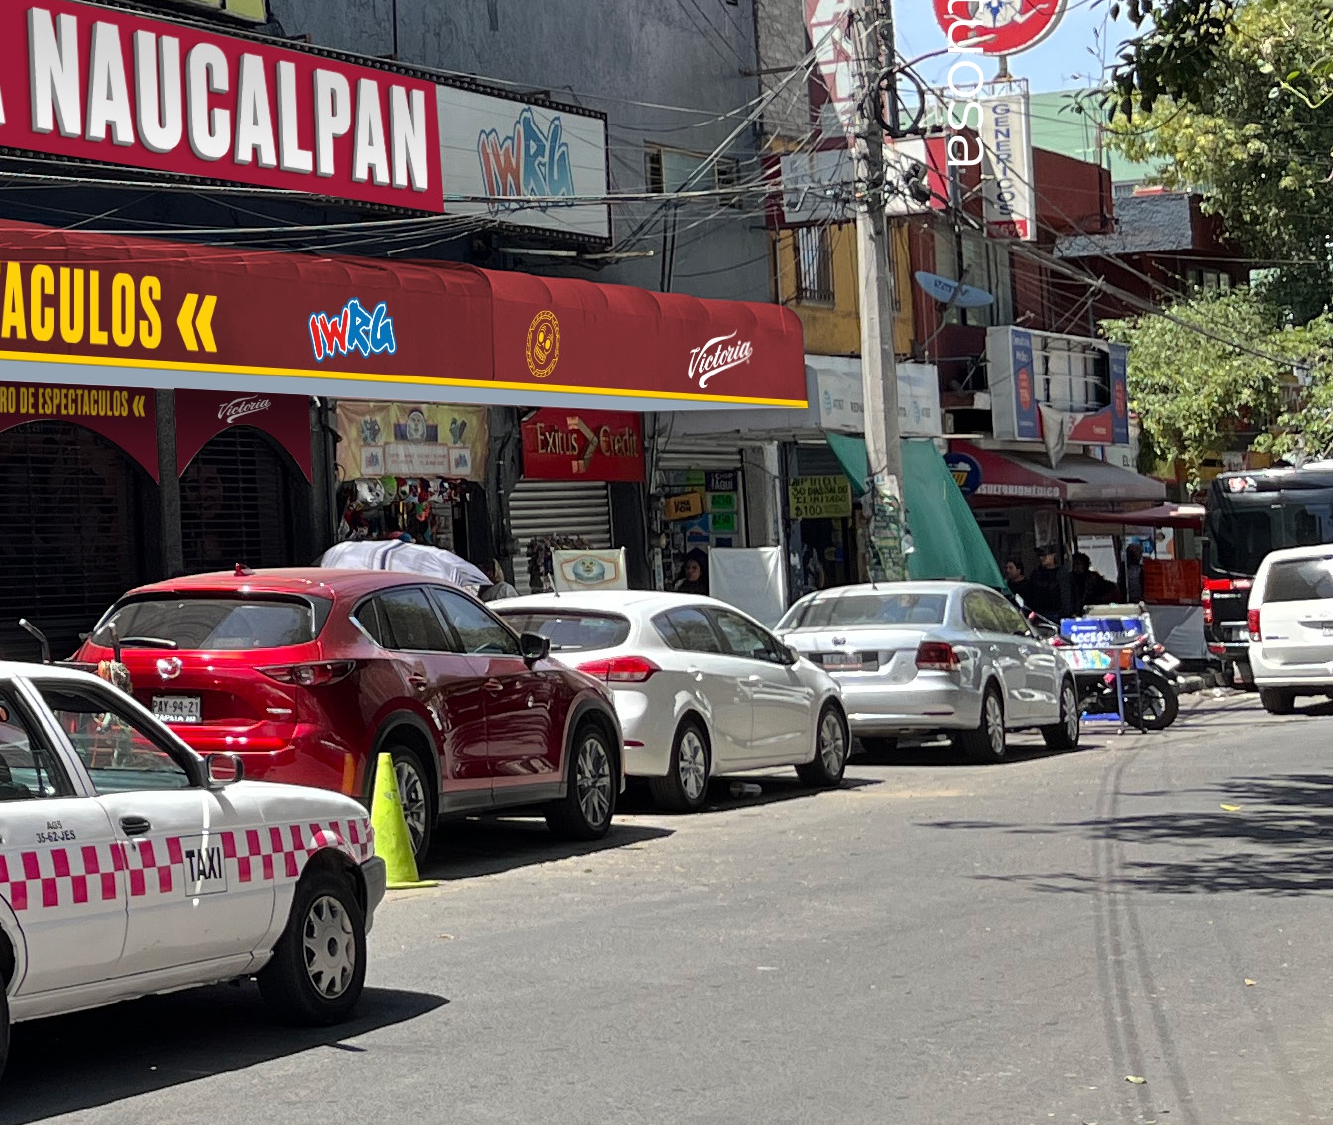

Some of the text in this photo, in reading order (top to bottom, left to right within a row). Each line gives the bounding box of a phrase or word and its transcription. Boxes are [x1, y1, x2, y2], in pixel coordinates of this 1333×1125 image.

[28, 6, 429, 192] NAUCALPAN
[308, 297, 398, 363] IWRG
[688, 329, 754, 389] Victoria
[19, 386, 36, 415] DE
[38, 387, 130, 417] ESPECTACULOS
[217, 393, 272, 424] Victoria
[536, 422, 639, 458] Exitus Credit
[184, 846, 224, 883] TAXI
